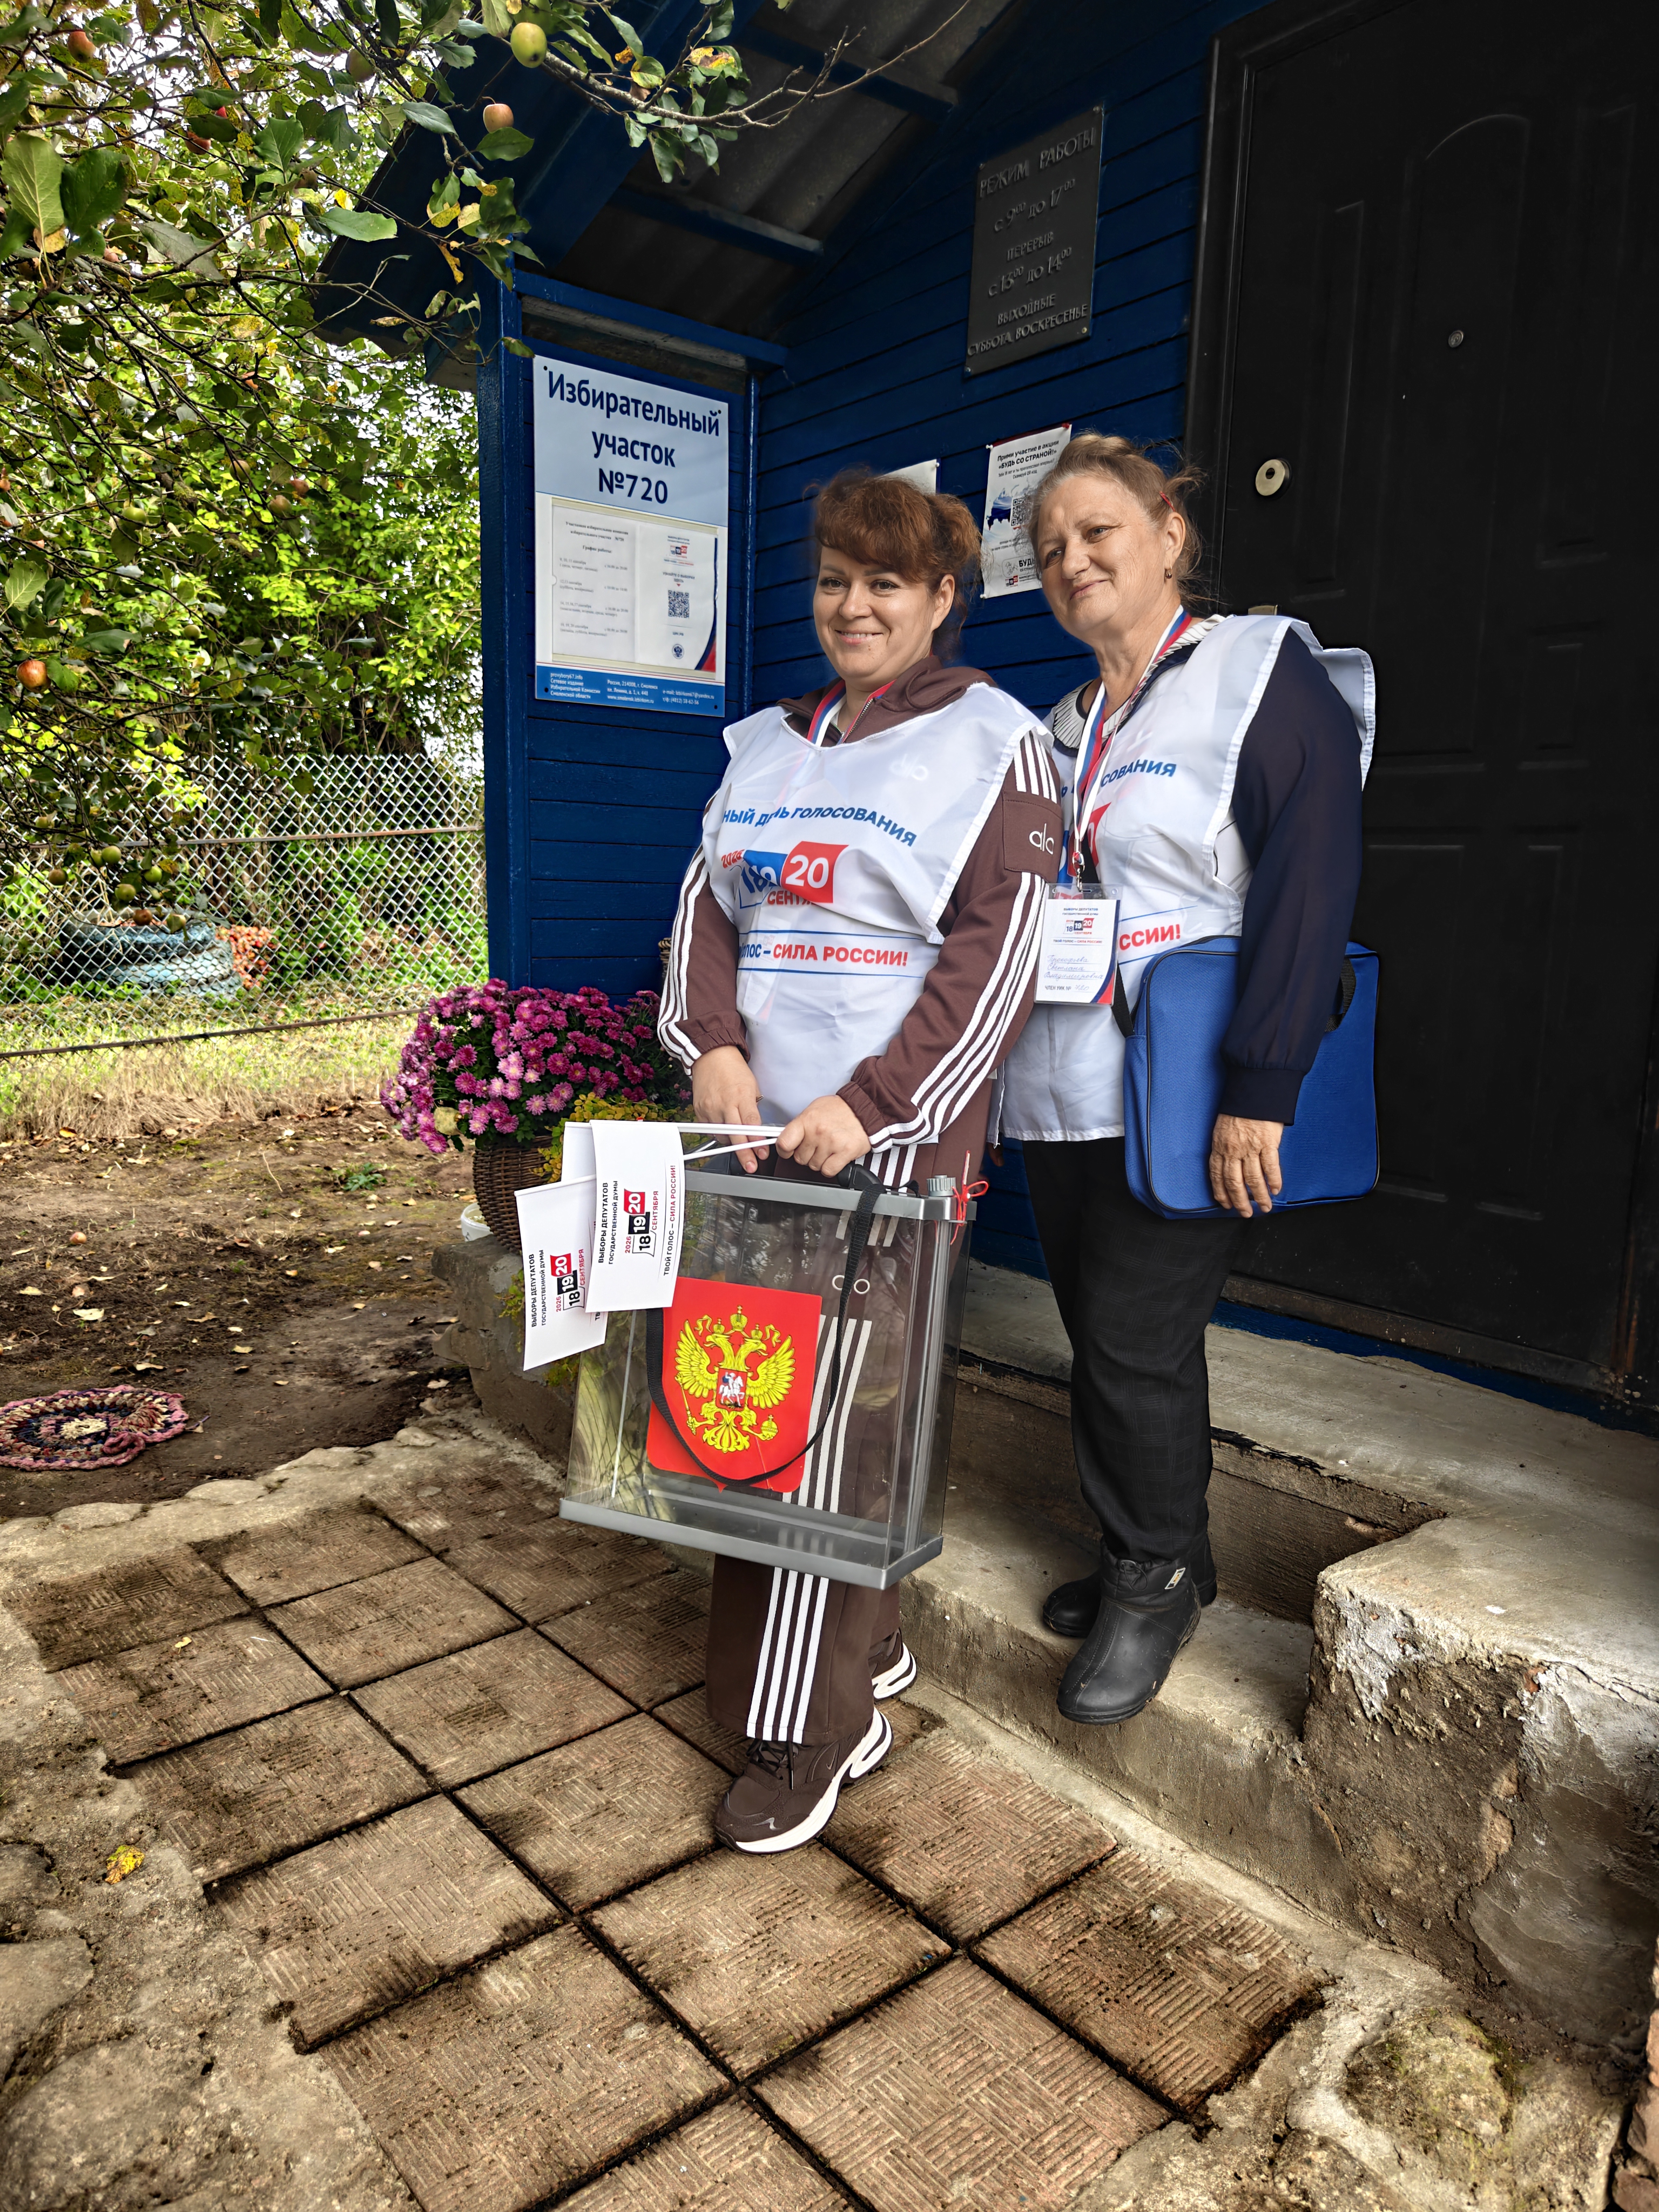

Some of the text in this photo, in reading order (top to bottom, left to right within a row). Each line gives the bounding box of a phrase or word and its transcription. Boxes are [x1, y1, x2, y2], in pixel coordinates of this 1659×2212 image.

[980, 127, 1096, 198] РЕЖИМ РАБОТЫ
[1007, 232, 1054, 261] ПЕРЕРЫВ
[997, 294, 1056, 326] ВЫХОДНЫЕ
[1016, 304, 1088, 340] ВОСКРЕСЕНЬЕ
[548, 370, 720, 437] Избирательный
[592, 431, 676, 468] участок
[997, 453, 1014, 462] Прими
[1015, 446, 1037, 458] участие
[1042, 440, 1059, 449] акции
[999, 460, 1015, 469] «БУДЬ
[1025, 448, 1057, 462] СТРАНОЙ!»
[599, 468, 668, 504] №720
[1101, 759, 1177, 788] СОВАНИЯ
[721, 808, 756, 825] НЫЙ
[791, 807, 917, 847] ГОЛОСОВАНИЯ
[785, 854, 829, 889] 20
[767, 891, 817, 905] СЕНТ
[773, 943, 818, 961] СИЛА
[822, 946, 908, 967] РОССИИ!
[1119, 924, 1181, 952] ССИИ!
[1047, 962, 1085, 972] Светлана
[609, 1202, 618, 1265] ГОСУДАРСТВЕННОЙ
[628, 1193, 651, 1251] 18 19 20
[598, 1230, 607, 1263] ВЫБОРЫ
[529, 1253, 537, 1296] ДЕПУТАТОВ
[555, 1256, 581, 1306] 18 19 20
